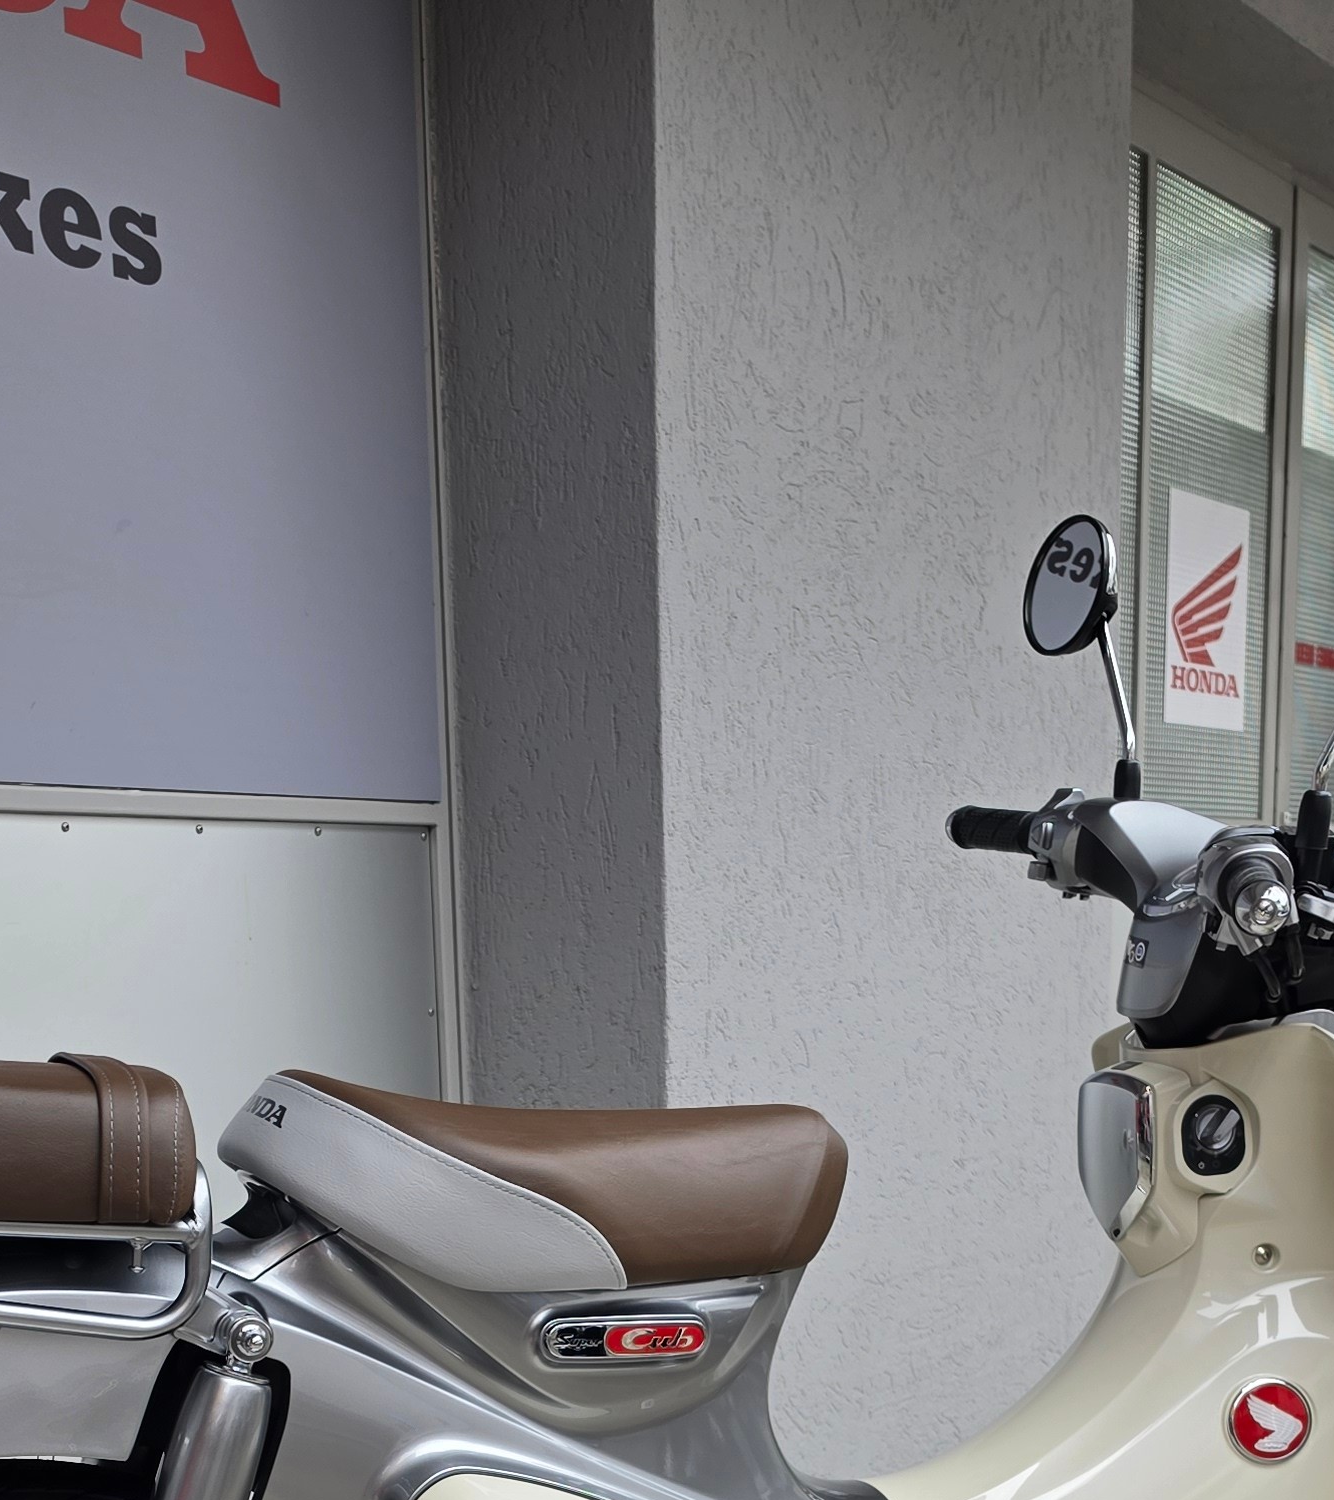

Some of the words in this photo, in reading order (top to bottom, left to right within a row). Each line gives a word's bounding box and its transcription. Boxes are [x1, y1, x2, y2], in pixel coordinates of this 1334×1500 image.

[1170, 664, 1240, 699] HONDA
[554, 1333, 604, 1351] Super
[621, 1327, 694, 1351] Cub
